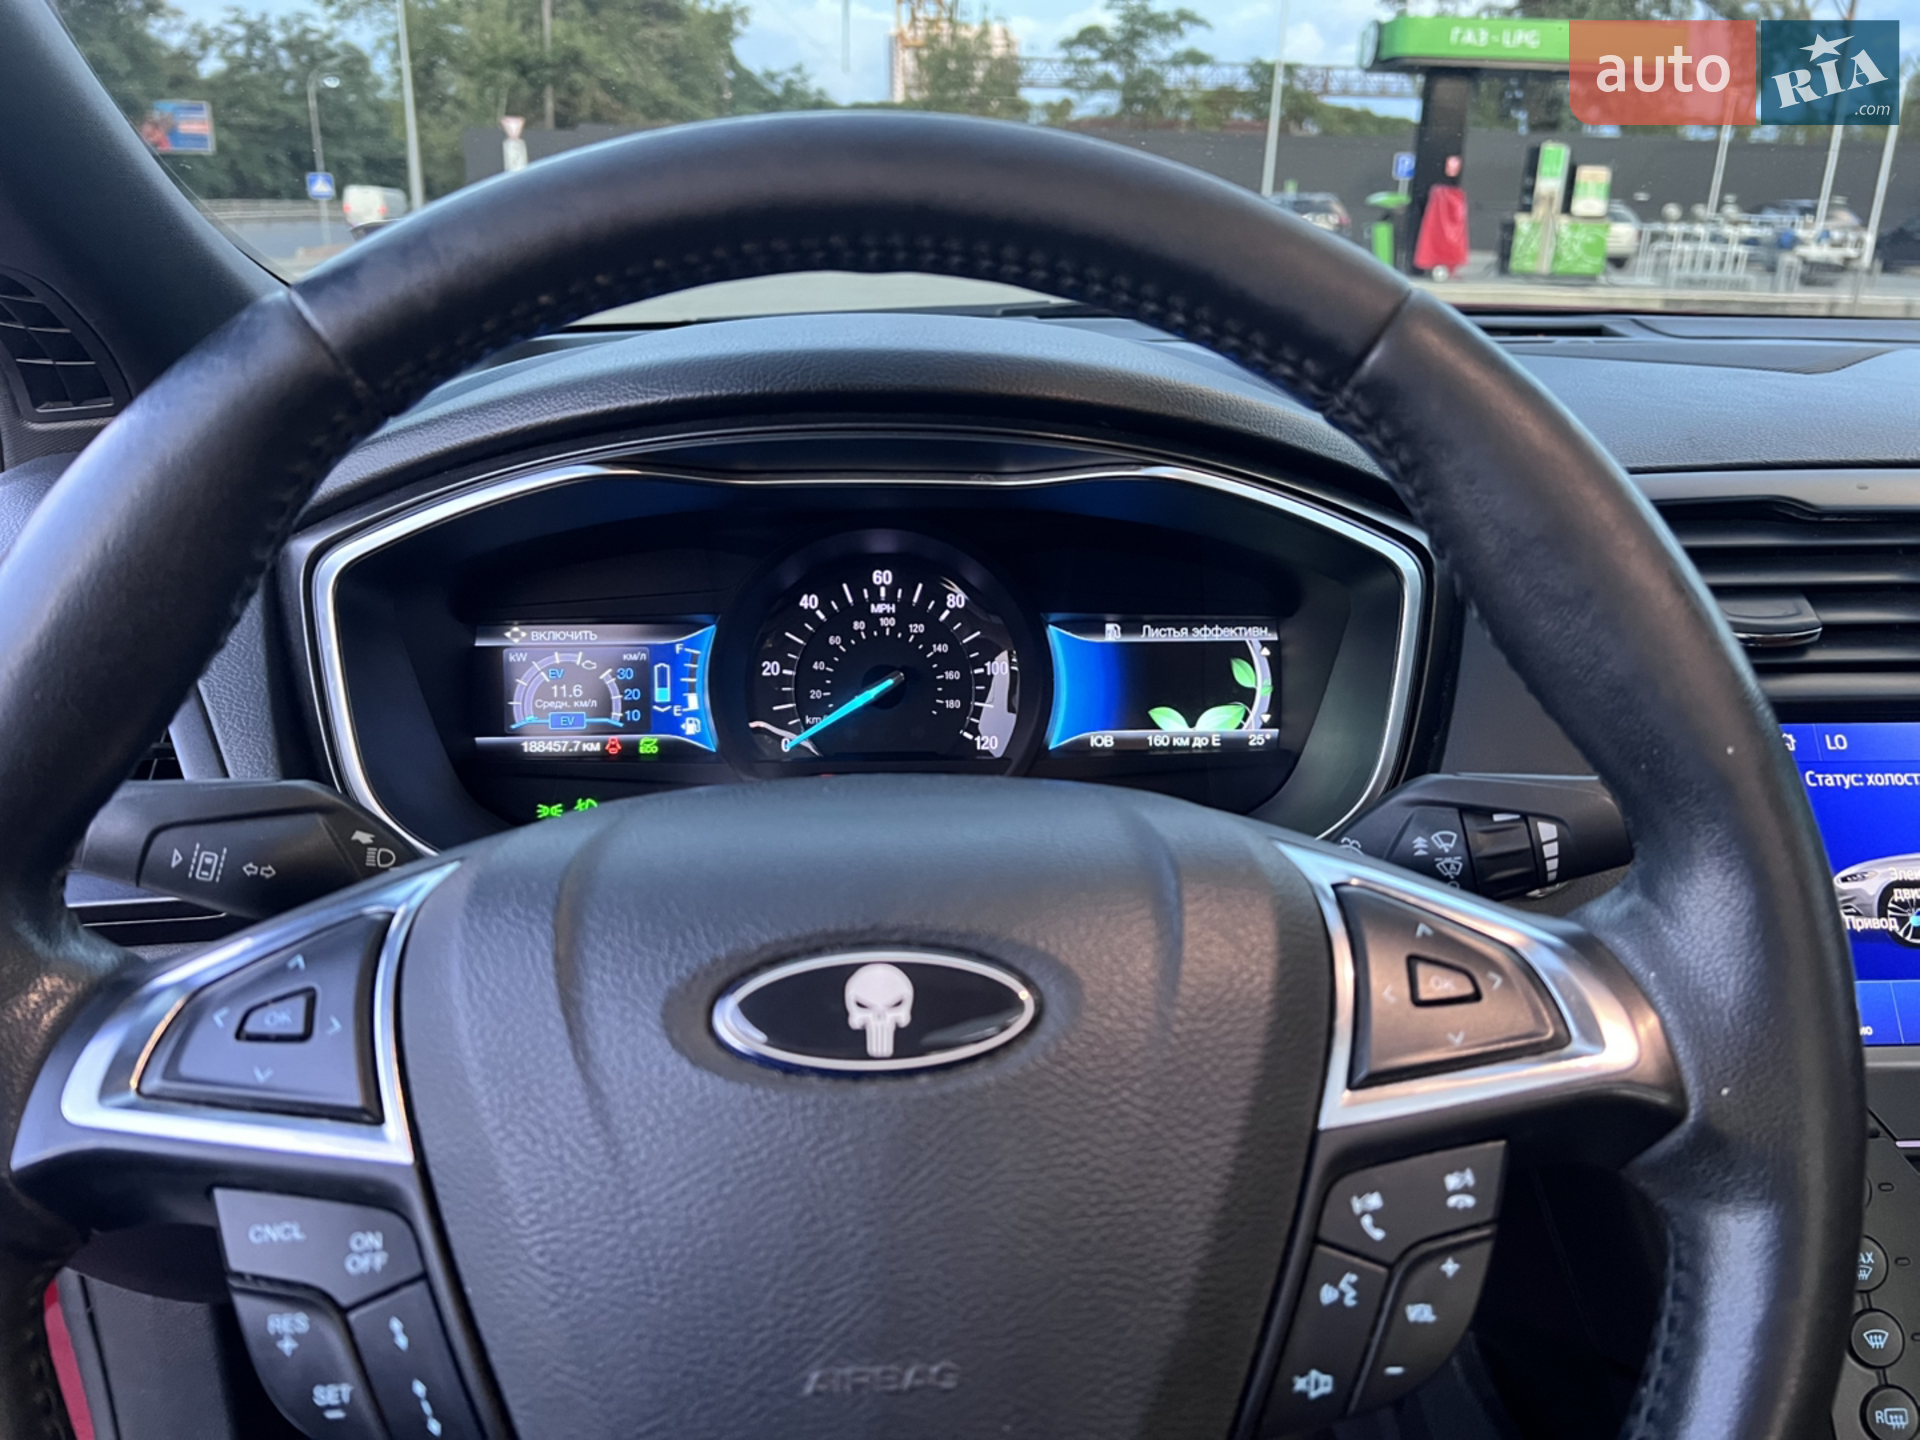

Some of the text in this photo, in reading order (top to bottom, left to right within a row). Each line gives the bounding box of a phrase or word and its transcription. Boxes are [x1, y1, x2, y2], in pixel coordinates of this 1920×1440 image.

[872, 570, 892, 585] 60
[799, 594, 818, 609] 40
[946, 593, 965, 609] 80
[870, 603, 896, 613] MPH
[853, 620, 866, 631] 80
[879, 617, 896, 627] 100
[908, 623, 925, 633] 120
[531, 630, 598, 642] ВКЛЮЧИТЬ
[1141, 625, 1271, 640] Листья эффективн.
[828, 635, 841, 646] 60
[675, 644, 683, 654] F
[932, 643, 948, 653] 140
[509, 652, 527, 662] kW
[623, 652, 647, 661] км/л
[762, 661, 780, 676] 20
[812, 661, 825, 671] 40
[985, 661, 1008, 676] 100
[548, 669, 565, 679] EV
[617, 668, 634, 680] 30
[944, 670, 960, 680] 160
[551, 685, 583, 698] 11.6
[624, 689, 640, 700] 20
[810, 689, 822, 699] 20
[535, 699, 597, 709] Средн. км/л
[945, 699, 960, 709] 180
[560, 716, 575, 725] EV
[625, 710, 640, 722] 10
[781, 738, 790, 752] 0
[974, 735, 998, 750] 120
[1090, 736, 1114, 748] ЮВ
[1147, 735, 1170, 747] 160
[1172, 737, 1190, 747] км
[1192, 737, 1209, 748] до
[1249, 734, 1271, 746] 25°
[1825, 734, 1848, 750] LO
[521, 741, 600, 753] 188457.7 км
[1805, 770, 1864, 790] Статус:
[1844, 916, 1899, 932] Привод
[263, 1009, 293, 1027] OK
[248, 1221, 306, 1244] CNCL
[349, 1231, 383, 1252] ON
[344, 1250, 389, 1274] OFF
[267, 1311, 310, 1335] RES
[802, 1360, 961, 1395] AIRBAG
[312, 1382, 353, 1406] SET
